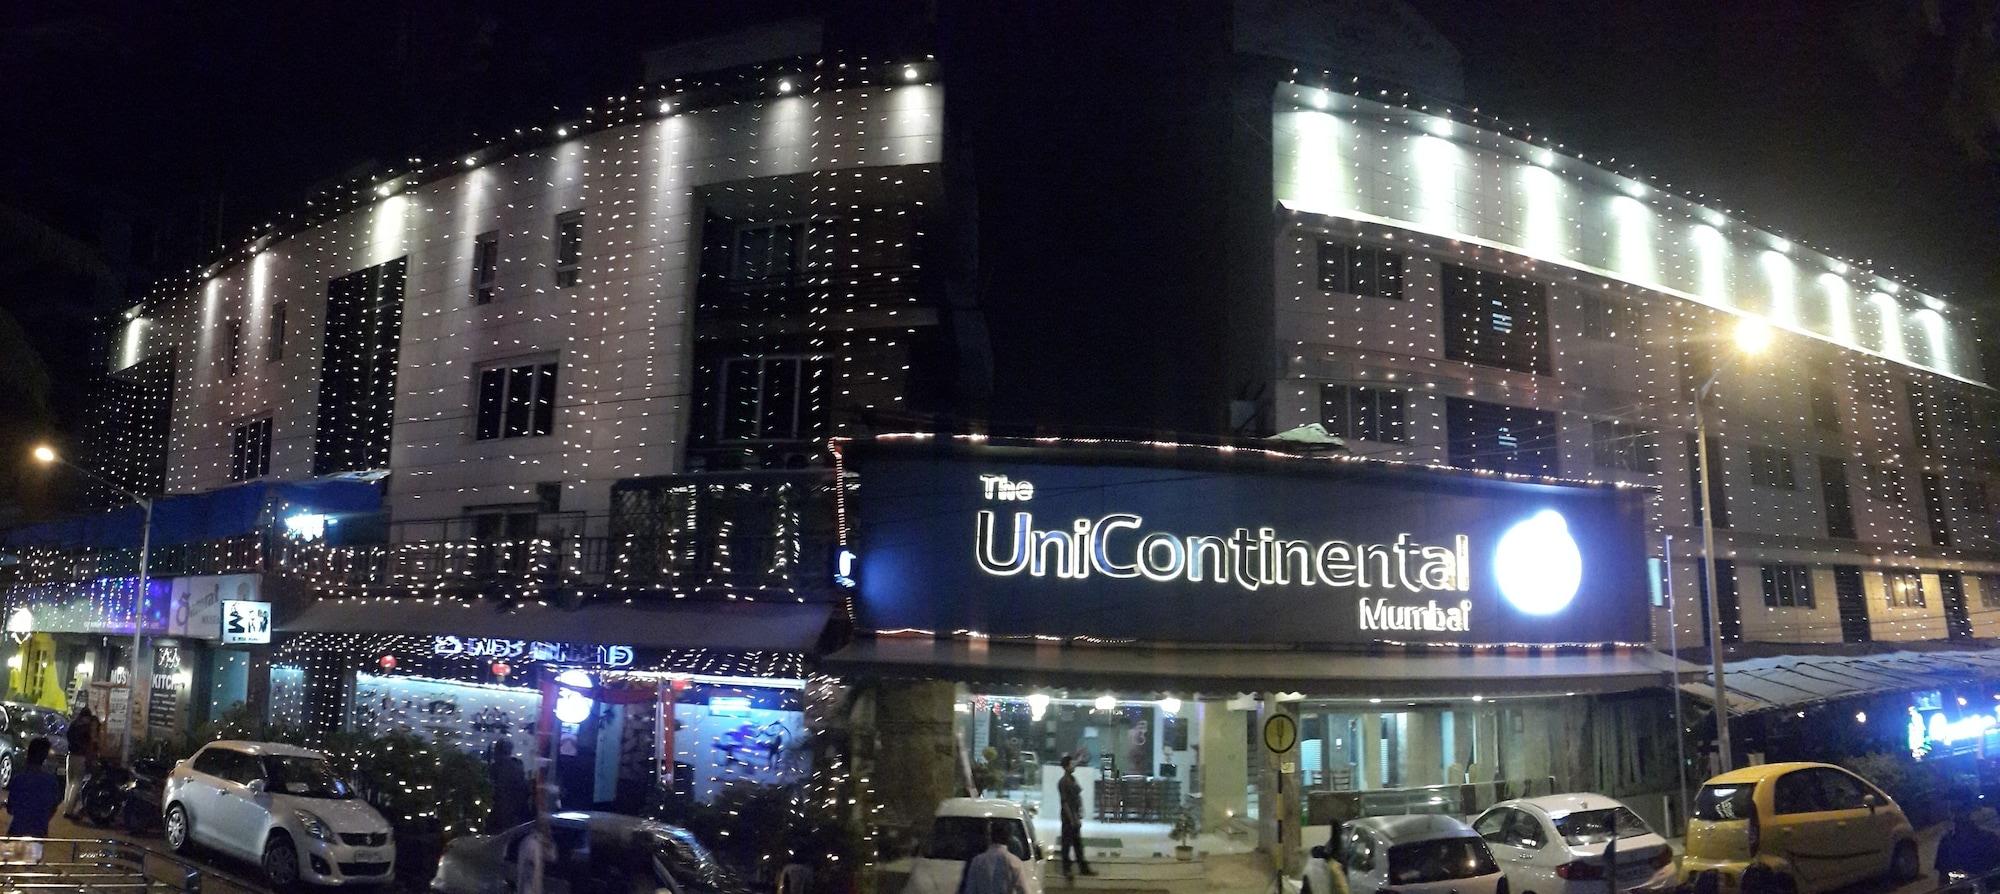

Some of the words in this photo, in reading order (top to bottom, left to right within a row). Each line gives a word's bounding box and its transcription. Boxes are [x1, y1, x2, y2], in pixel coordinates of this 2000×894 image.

[980, 474, 1034, 501] The
[976, 509, 1470, 593] UniContinental
[1358, 597, 1472, 632] Mumbai
